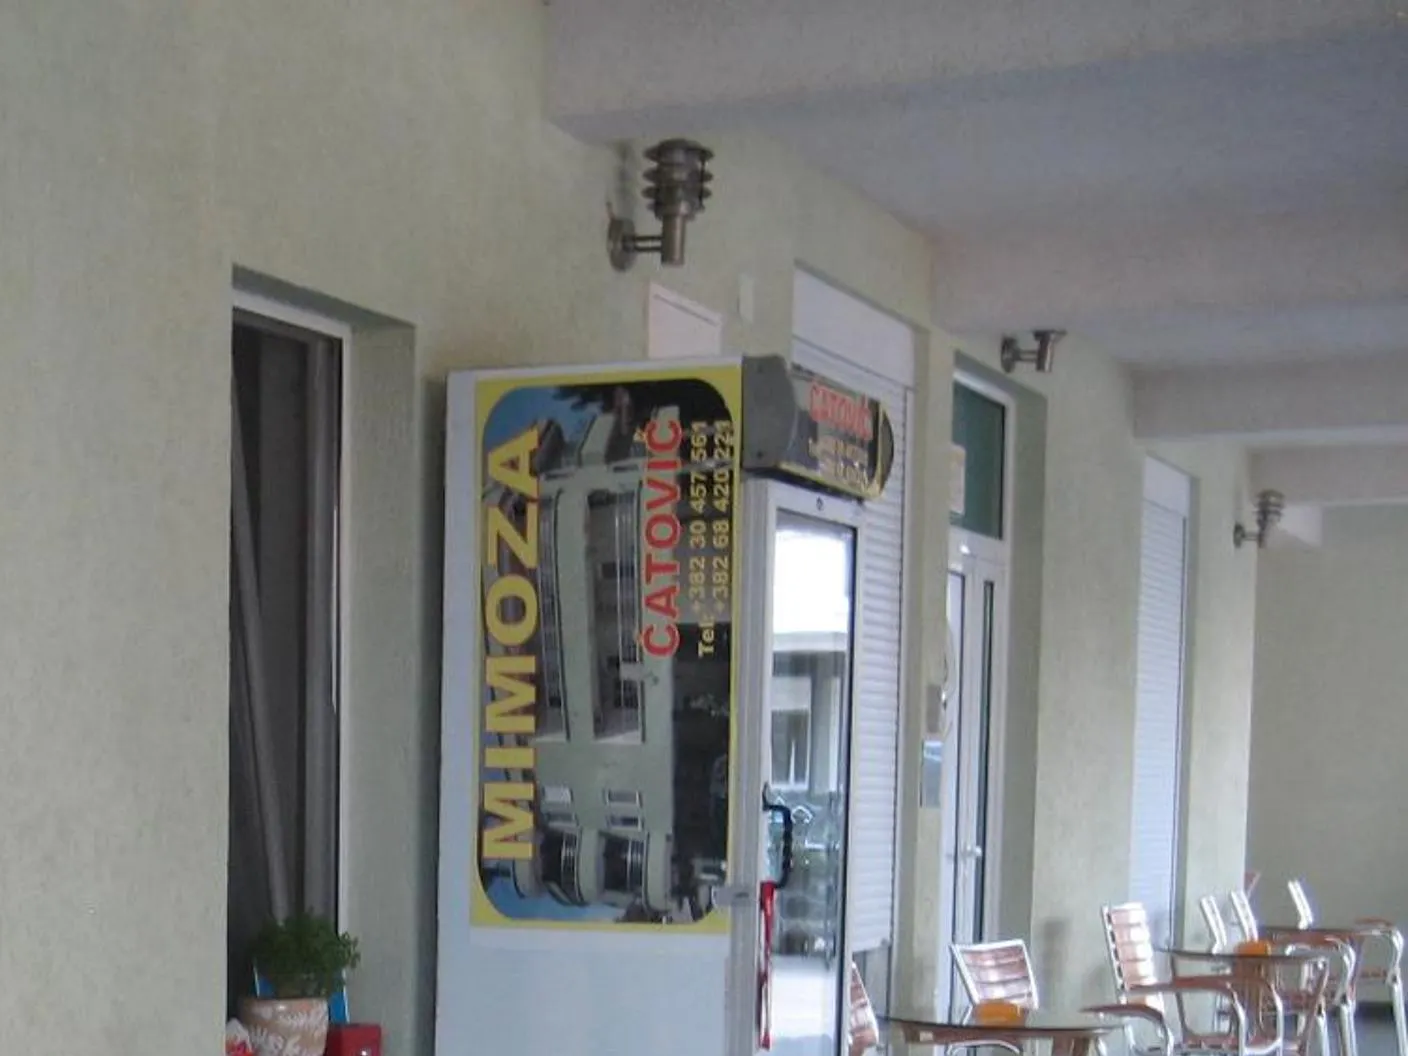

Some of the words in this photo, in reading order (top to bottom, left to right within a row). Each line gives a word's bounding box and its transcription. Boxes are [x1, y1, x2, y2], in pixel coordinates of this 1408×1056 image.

[691, 421, 708, 462] 561
[690, 471, 707, 514] 457
[713, 469, 730, 513] 420
[689, 520, 707, 549] 30
[712, 520, 730, 549] 68
[483, 424, 540, 861] MIMOZA
